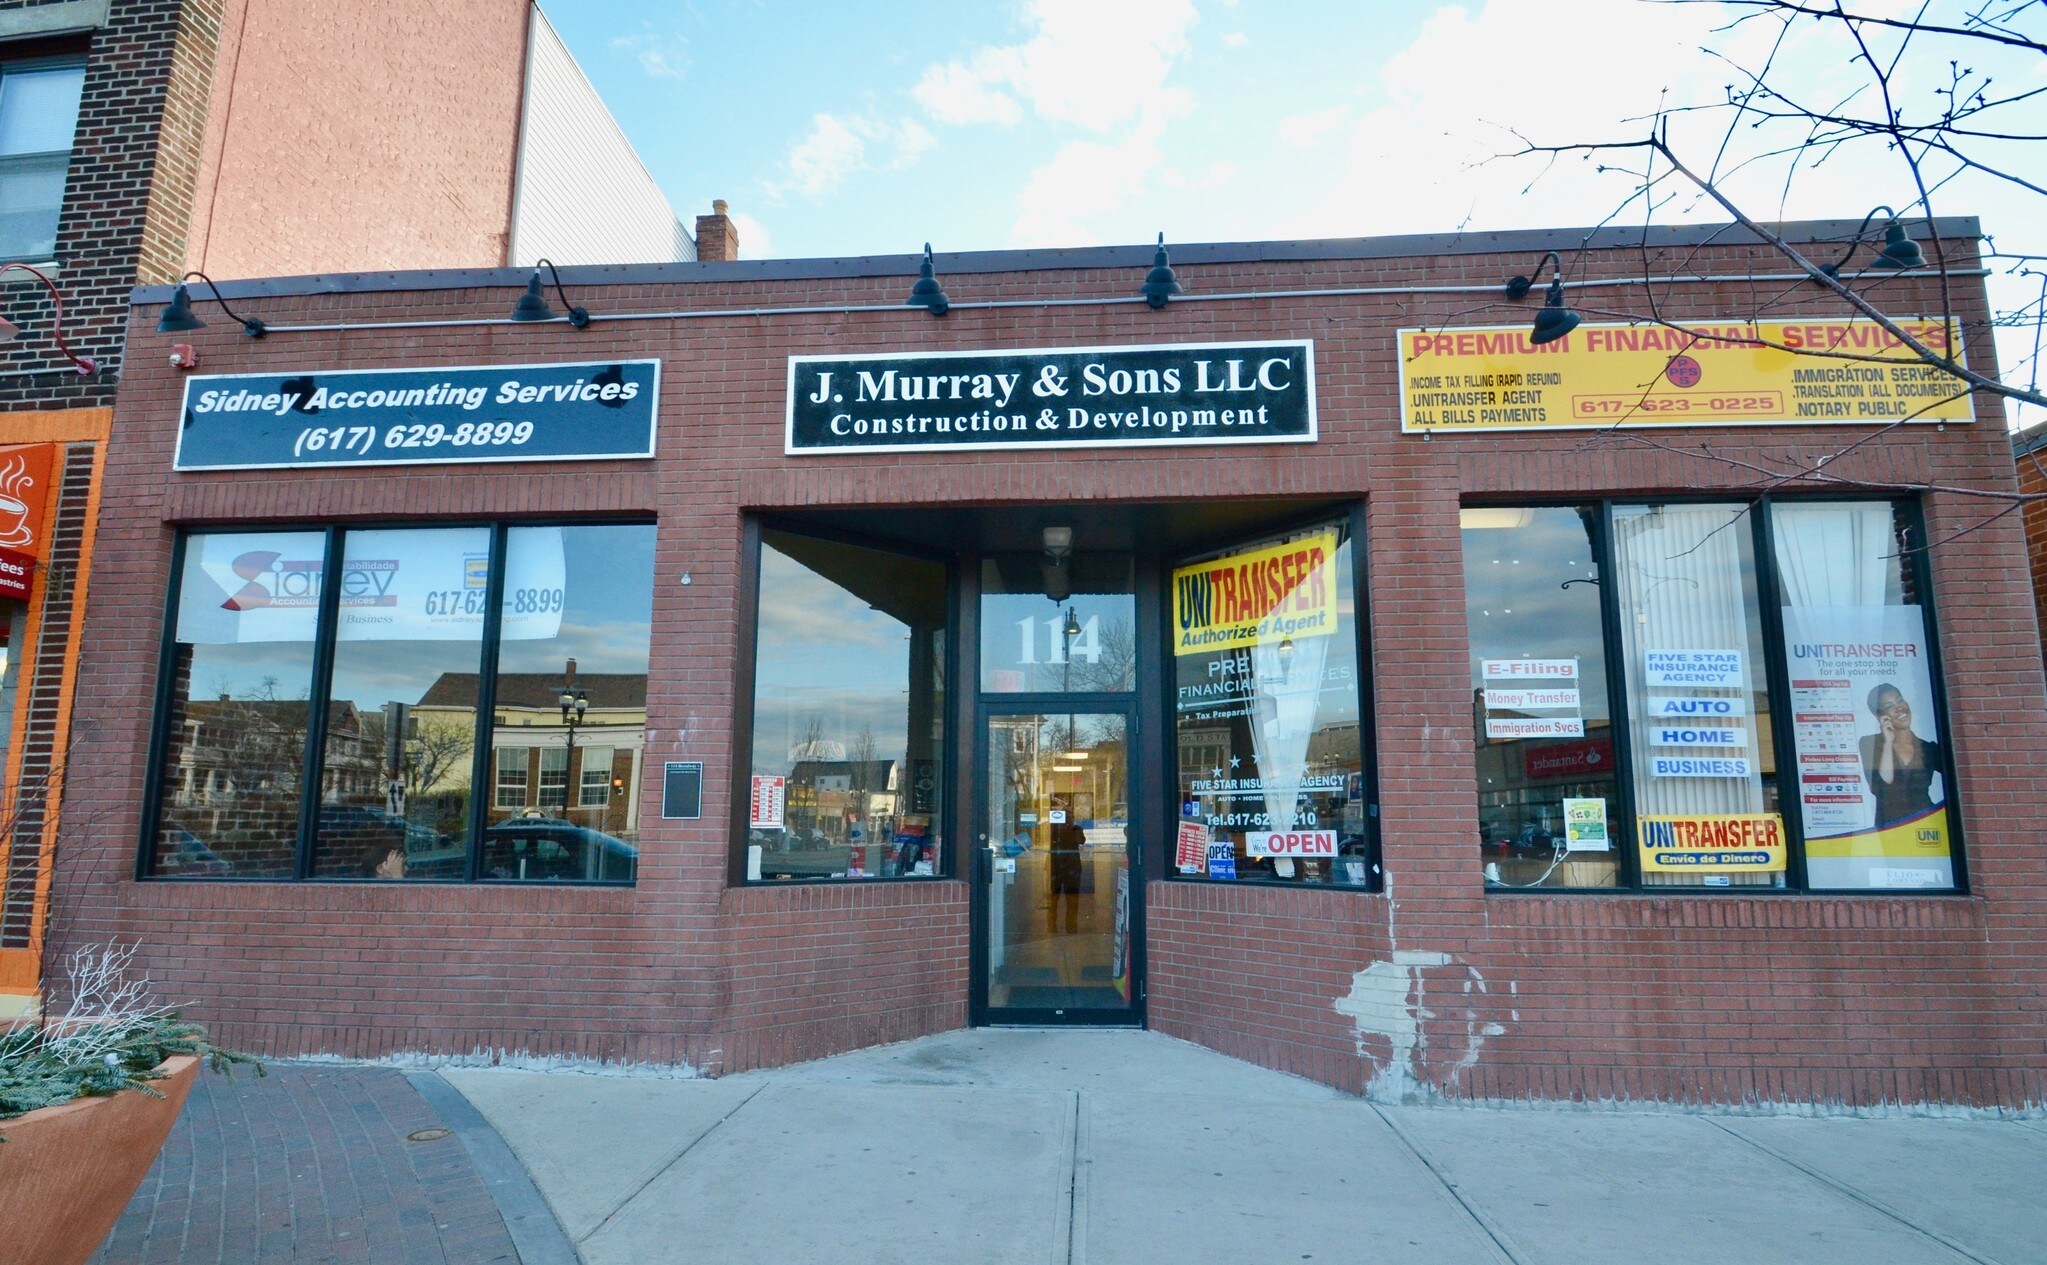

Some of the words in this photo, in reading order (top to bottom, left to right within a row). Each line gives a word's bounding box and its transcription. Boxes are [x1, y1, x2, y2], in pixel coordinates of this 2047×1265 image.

[1413, 332, 1569, 356] PREMIUM
[1586, 327, 1766, 353] FINANCIAL
[1784, 325, 1948, 348] SERVICES
[1445, 375, 1460, 388] TAX
[1464, 374, 1493, 387] FILLING
[1496, 373, 1523, 387] (RAPID
[1526, 372, 1561, 386] REFUND)
[1669, 368, 1698, 376] PFS
[1891, 367, 1957, 381] SERVICES
[810, 372, 843, 404] J.
[855, 370, 1020, 408] Murray
[1032, 364, 1069, 397] &
[1083, 363, 1181, 396] Sons
[1193, 357, 1291, 392] LLC
[1868, 383, 1893, 398] (ALL
[1896, 382, 1962, 398] DOCUMENTS)
[196, 389, 300, 416] Sidney
[303, 382, 487, 411] Accounting
[496, 378, 639, 404] Services
[1502, 389, 1543, 405] AGENT
[1442, 408, 1475, 423] BILLS
[1481, 407, 1546, 423] PAYMENTS
[1858, 400, 1907, 416] PUBLIC
[830, 410, 1028, 435] Construction
[1035, 408, 1060, 430] &
[1067, 404, 1269, 432] Development
[294, 425, 376, 457] (617)
[384, 421, 534, 448] 629-8899
[220, 550, 396, 611] Sidey
[1178, 546, 1326, 631] UNITRANSFER
[269, 596, 320, 606] Accountin
[340, 596, 376, 606] ervices
[425, 588, 564, 615] 617-62-8899
[1181, 621, 1268, 647] Authorized
[1272, 610, 1326, 635] Agent
[1015, 614, 1103, 664] 114
[1648, 653, 1687, 662] FIVE
[1693, 654, 1738, 662] STAR
[1793, 643, 1917, 659] UNITRANSFER
[1488, 663, 1573, 676] E-Filing
[1649, 663, 1739, 672] INSURANCE
[1817, 660, 1833, 668] The
[1854, 661, 1874, 669] stop
[1876, 660, 1898, 669] shop
[1820, 668, 1832, 676] for
[1835, 668, 1845, 676] all
[1848, 669, 1868, 677] your
[1870, 668, 1897, 676] needs
[1663, 673, 1727, 682] AGENCY
[1179, 678, 1259, 699] FINANCIAL
[1488, 692, 1524, 707] Money
[1527, 691, 1577, 704] Transfer
[1664, 700, 1731, 713] AUTO
[1196, 712, 1211, 720] Tax
[1213, 707, 1258, 719] Preparatio
[1489, 722, 1552, 736] Immigration
[1554, 722, 1580, 733] Svcs
[1662, 730, 1735, 743] HOME
[1656, 760, 1746, 774] BUSINESS
[1191, 779, 1212, 791] FIVE
[1213, 778, 1238, 790] STAR
[1300, 774, 1346, 788] AGENCY
[1205, 812, 1316, 826] Tel.617-623-210
[1641, 819, 1780, 848] UNITRANSFER
[1917, 830, 1939, 841] UNI
[1267, 833, 1332, 854] OPEN
[1209, 845, 1234, 859] OPEN
[1700, 853, 1718, 863] de
[1721, 853, 1767, 863] Dinero
